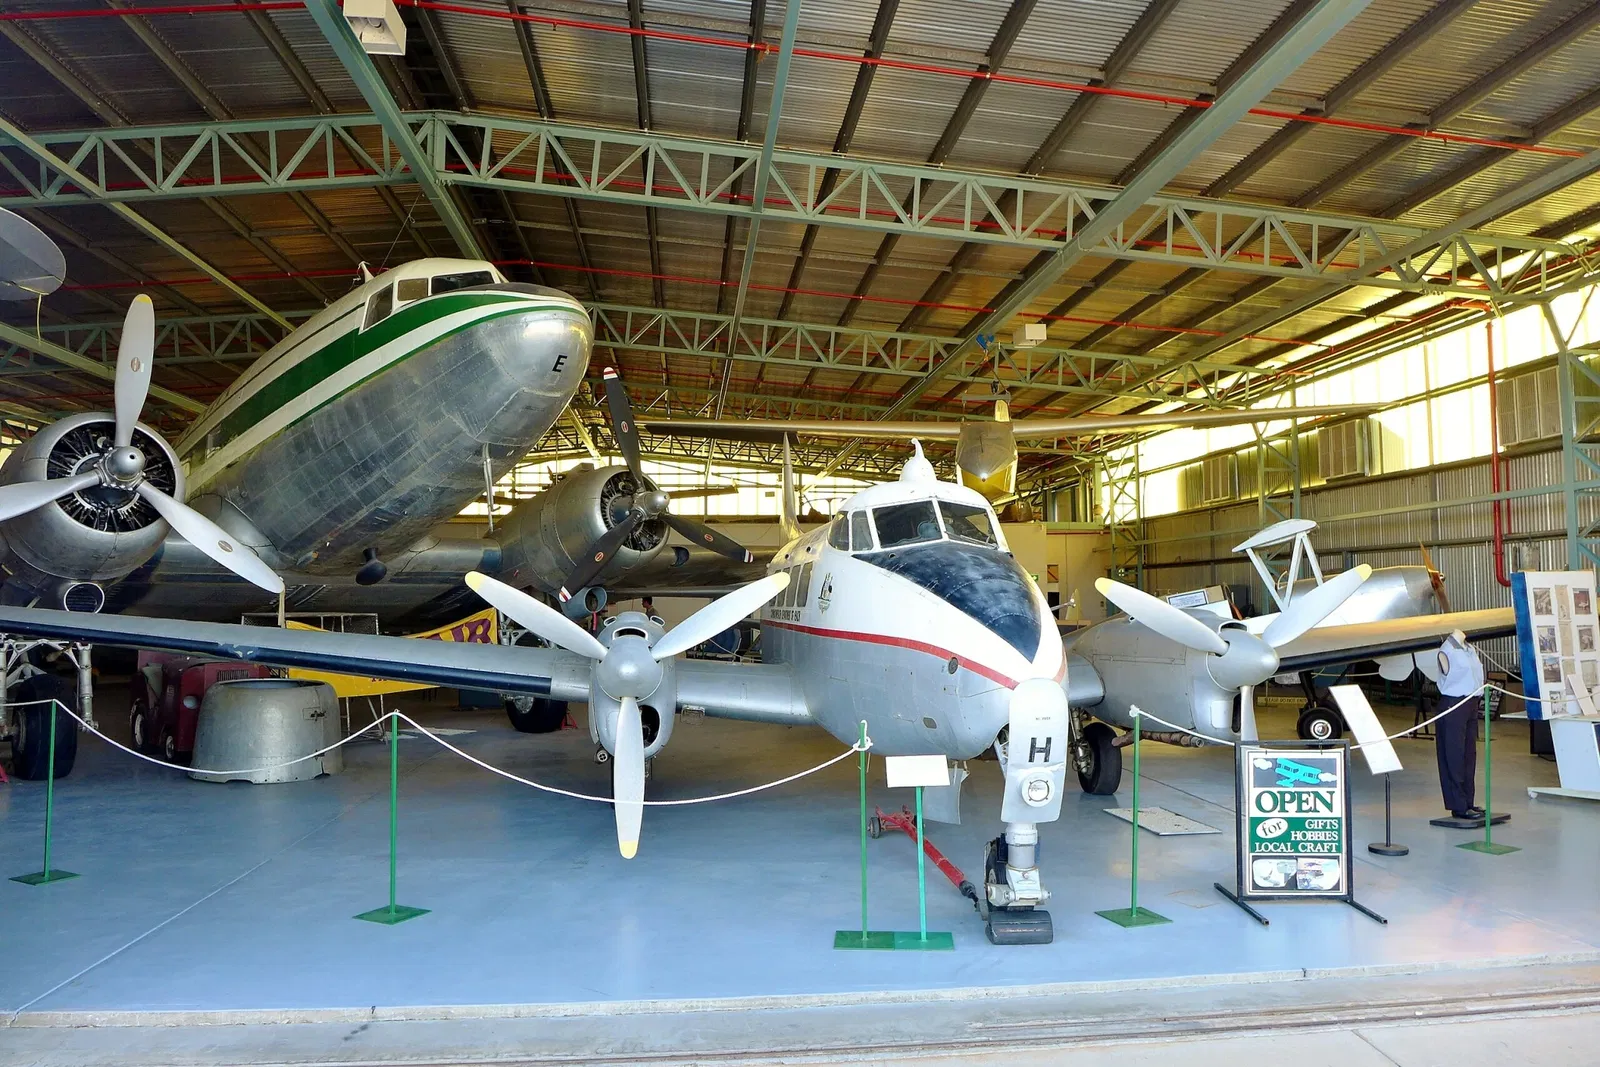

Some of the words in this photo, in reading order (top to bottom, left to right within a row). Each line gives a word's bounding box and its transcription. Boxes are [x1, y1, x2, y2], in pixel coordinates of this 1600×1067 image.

[552, 354, 568, 372] E
[1028, 737, 1052, 763] H
[1255, 790, 1335, 813] OPEN
[1261, 819, 1283, 837] for
[1305, 819, 1339, 829] GIFTS
[1291, 830, 1339, 841] HOBBIES
[1255, 842, 1294, 853] LOCAL
[1298, 842, 1339, 853] CRAFT
